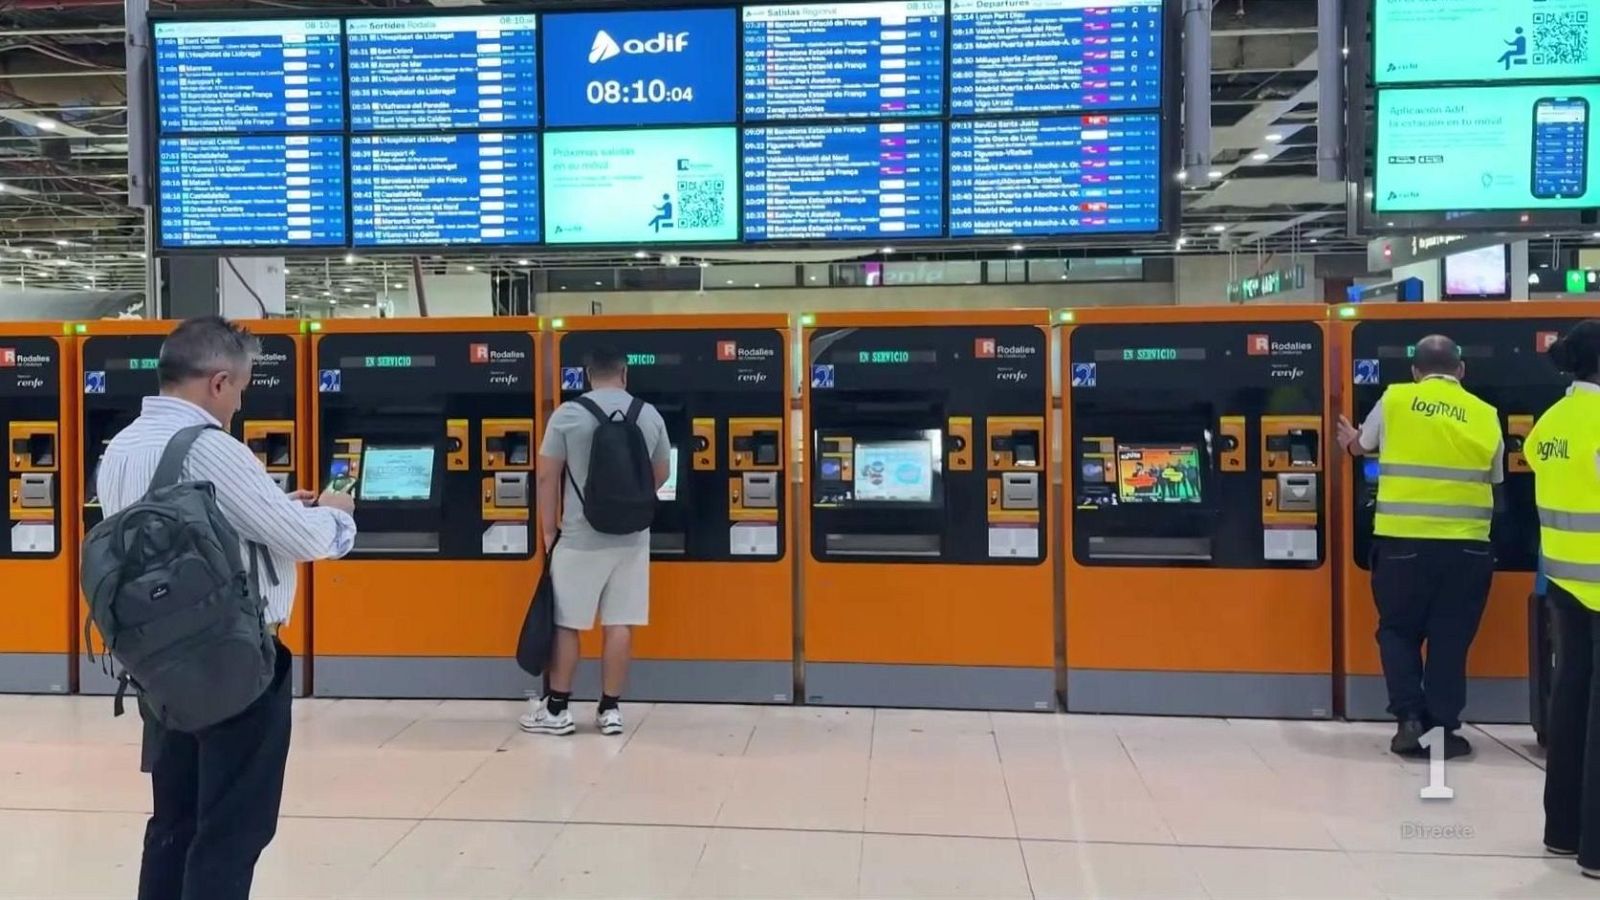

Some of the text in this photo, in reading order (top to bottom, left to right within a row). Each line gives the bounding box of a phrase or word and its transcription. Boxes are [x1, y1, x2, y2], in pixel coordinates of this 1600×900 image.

[976, 0, 1029, 8] Departures
[624, 32, 689, 54] adif
[587, 79, 694, 104] 08:10:04
[997, 346, 1036, 354] Rodalies
[1272, 342, 1312, 350] Rodalies
[17, 354, 50, 363] Rodalies
[490, 350, 525, 359] Rodalies
[738, 348, 774, 357] Rodalies
[860, 350, 909, 363] EN SERVICIO
[1137, 348, 1177, 361] SERVICIO
[366, 356, 411, 368] EN SERVICIO
[737, 372, 767, 385] renfe
[996, 370, 1028, 382] renfe
[1271, 367, 1304, 380] renfe
[17, 378, 44, 388] renfe
[490, 374, 518, 386] renfe
[1411, 396, 1468, 424] logiTRAIL
